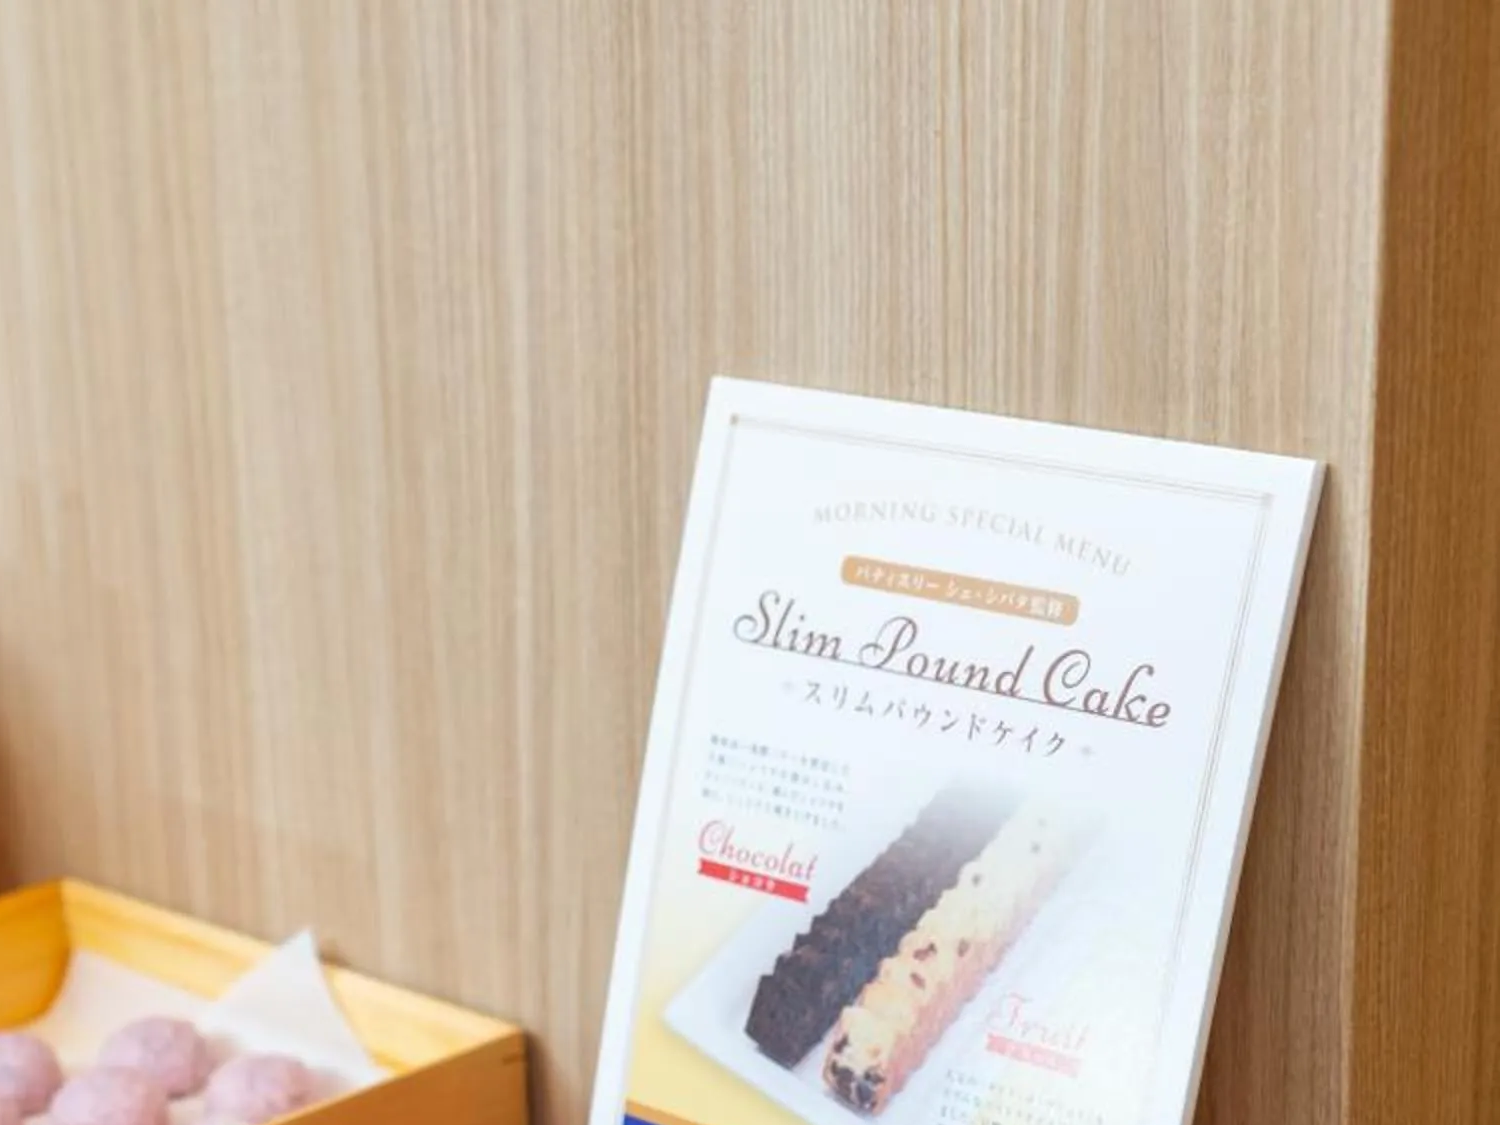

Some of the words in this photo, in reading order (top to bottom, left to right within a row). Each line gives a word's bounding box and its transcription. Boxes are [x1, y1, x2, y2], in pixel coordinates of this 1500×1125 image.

[813, 499, 938, 526] MORNING
[947, 504, 1047, 546] SPECIAL
[1054, 531, 1133, 577] MENU
[853, 564, 941, 592] パティスリー
[733, 589, 843, 660] Slim
[857, 614, 1031, 700] Pound
[1041, 647, 1172, 730] Cake
[697, 820, 818, 880] Chocolat
